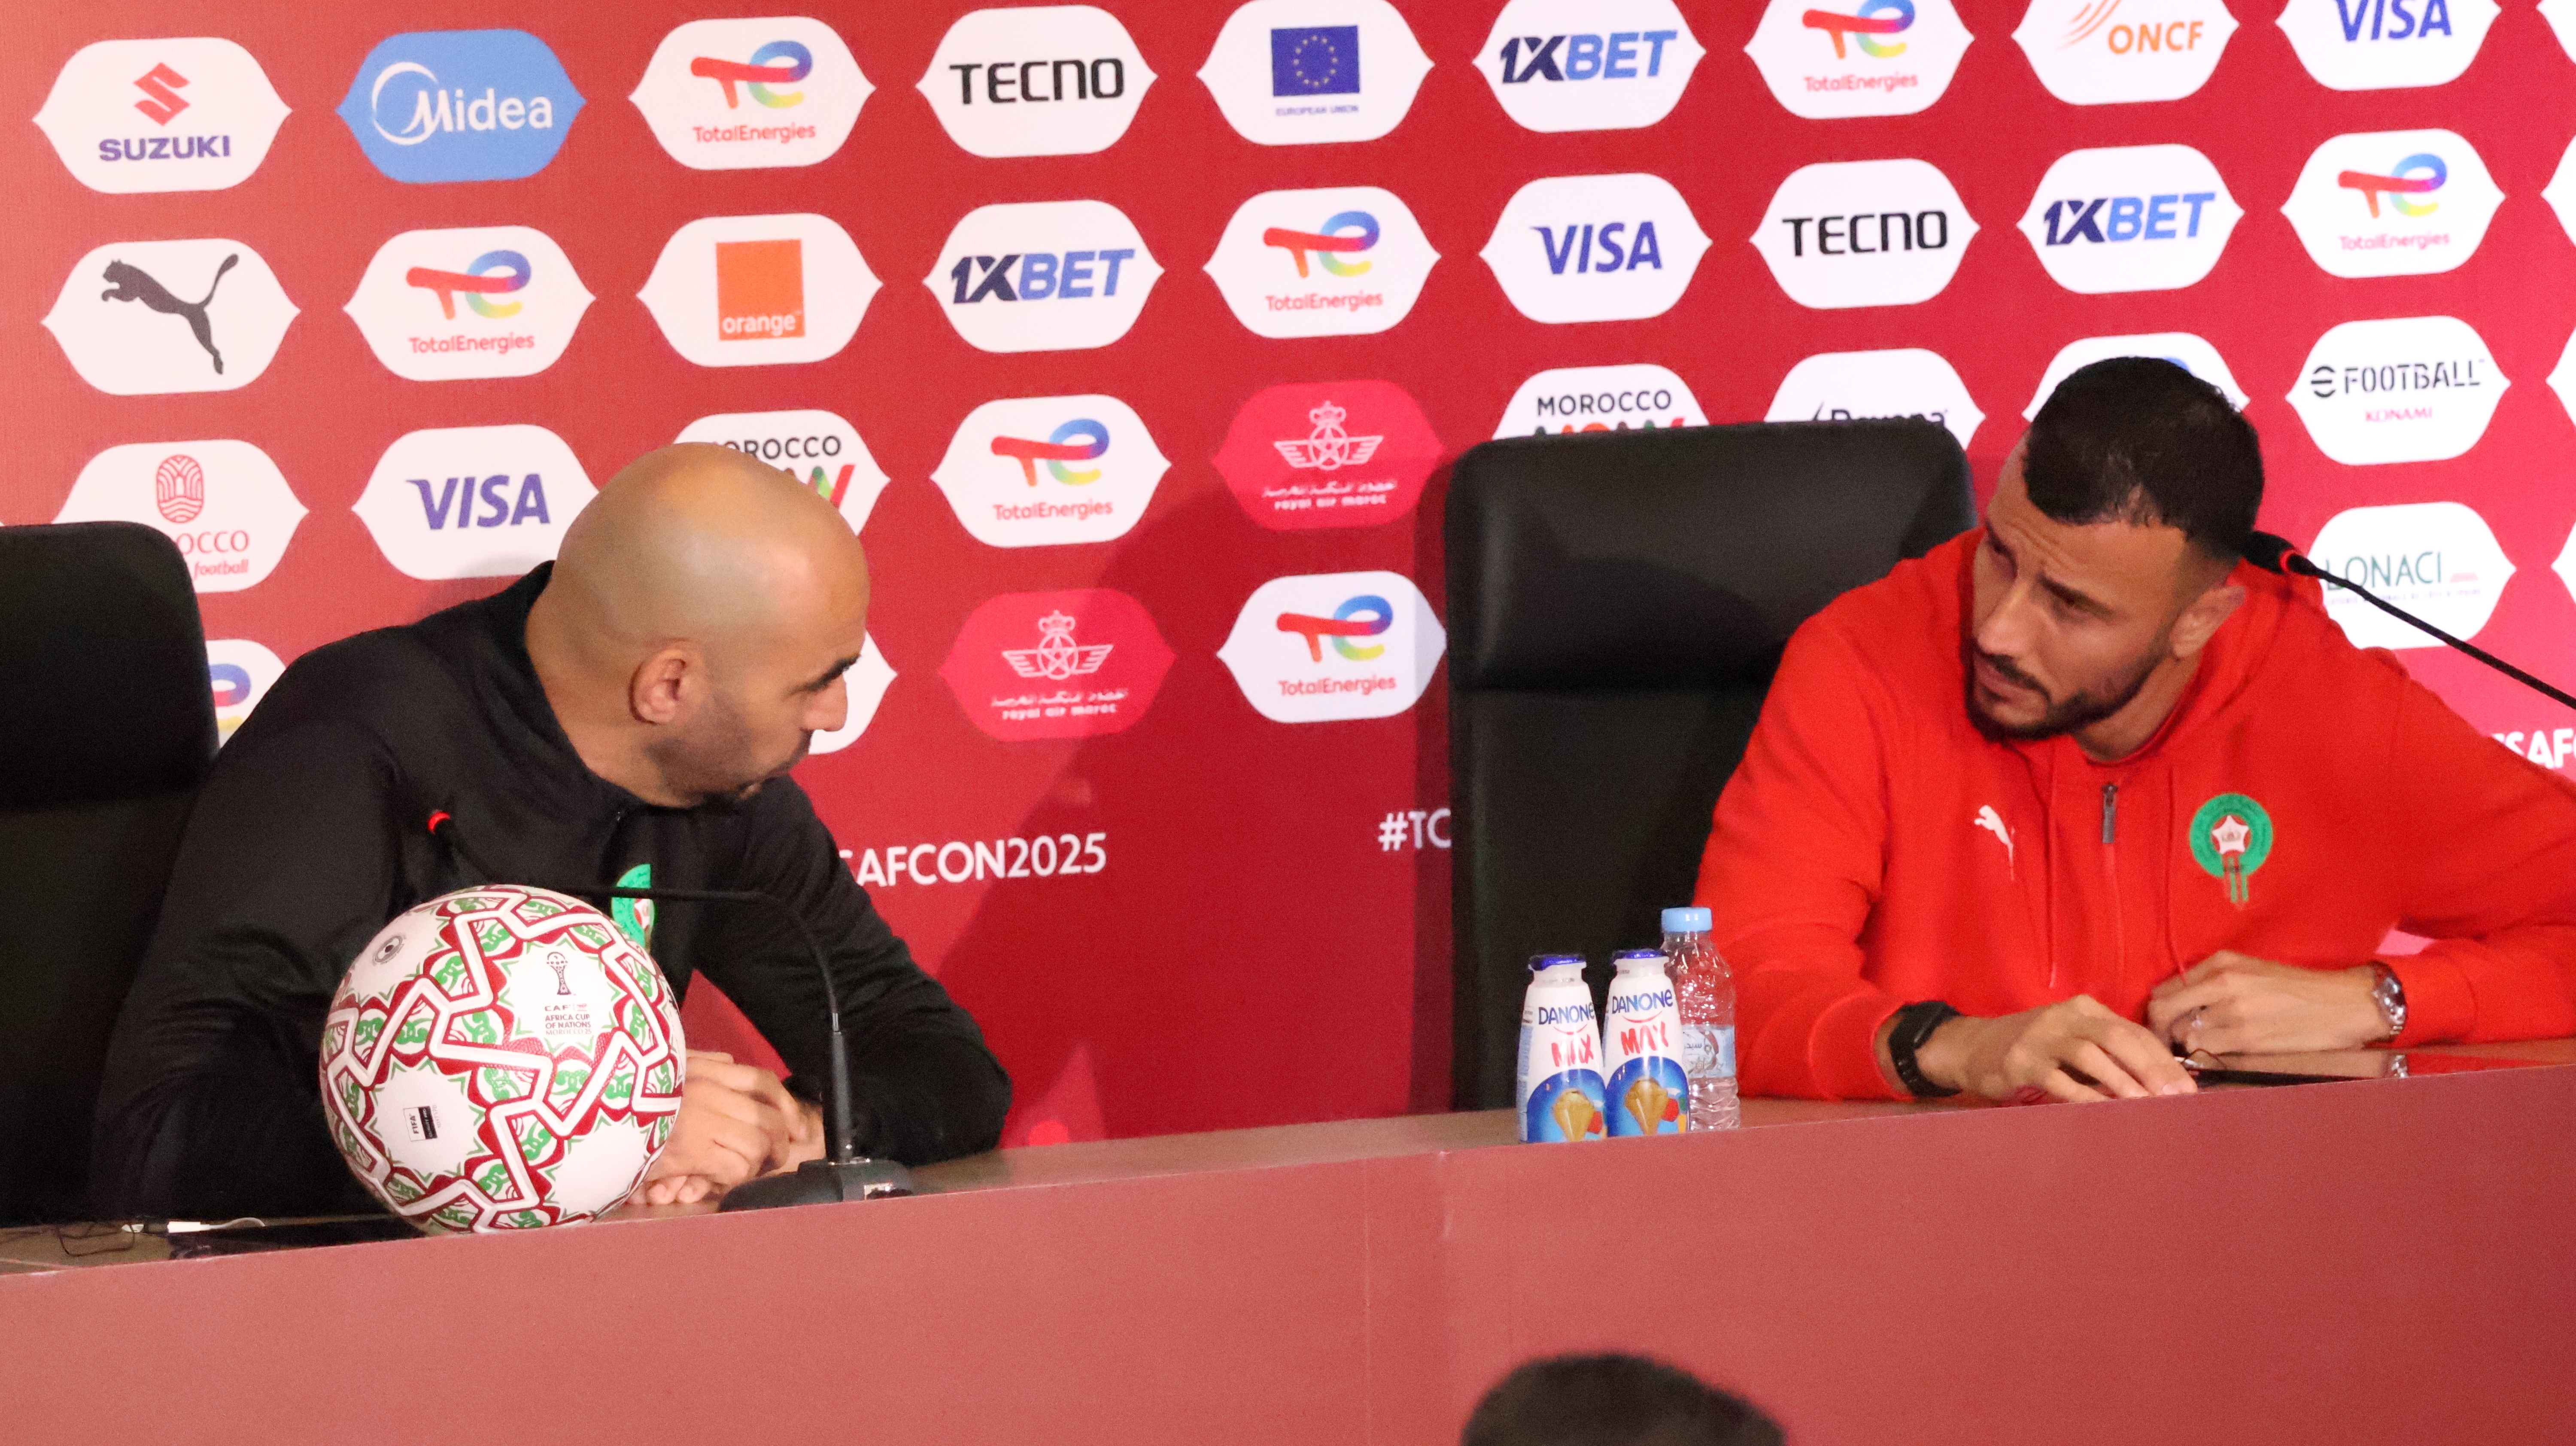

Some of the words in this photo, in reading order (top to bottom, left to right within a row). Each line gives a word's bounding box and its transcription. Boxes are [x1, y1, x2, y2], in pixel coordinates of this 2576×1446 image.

[2333, 0, 2452, 42] VISA
[2108, 21, 2203, 55] ONCF
[1500, 30, 1677, 84] 1XBET
[949, 58, 1124, 104] TECNO
[1804, 73, 1918, 93] TotalEnergies
[402, 88, 553, 134] Midea
[99, 135, 230, 161] SUZUKI
[693, 122, 816, 144] TotalEnergies
[1782, 210, 1948, 257] TECNO
[2044, 192, 2215, 246] 1XBET
[1530, 221, 1662, 275] VISA
[2339, 233, 2450, 251] TotalEnergies
[951, 249, 1134, 304] 1XBET
[1265, 292, 1383, 312] TotalEnergies
[723, 312, 796, 336] orange
[409, 332, 535, 355] TotalEnergies
[1537, 389, 1672, 416] MOROCCO
[2365, 407, 2432, 422] KONAMI
[405, 473, 551, 530] VISA
[993, 501, 1113, 521] TotalEnergies
[176, 530, 249, 555] OCCO
[2326, 551, 2441, 591] LONACI
[1278, 675, 1396, 696] TotalEnergies
[839, 832, 1107, 887] AFCON2025
